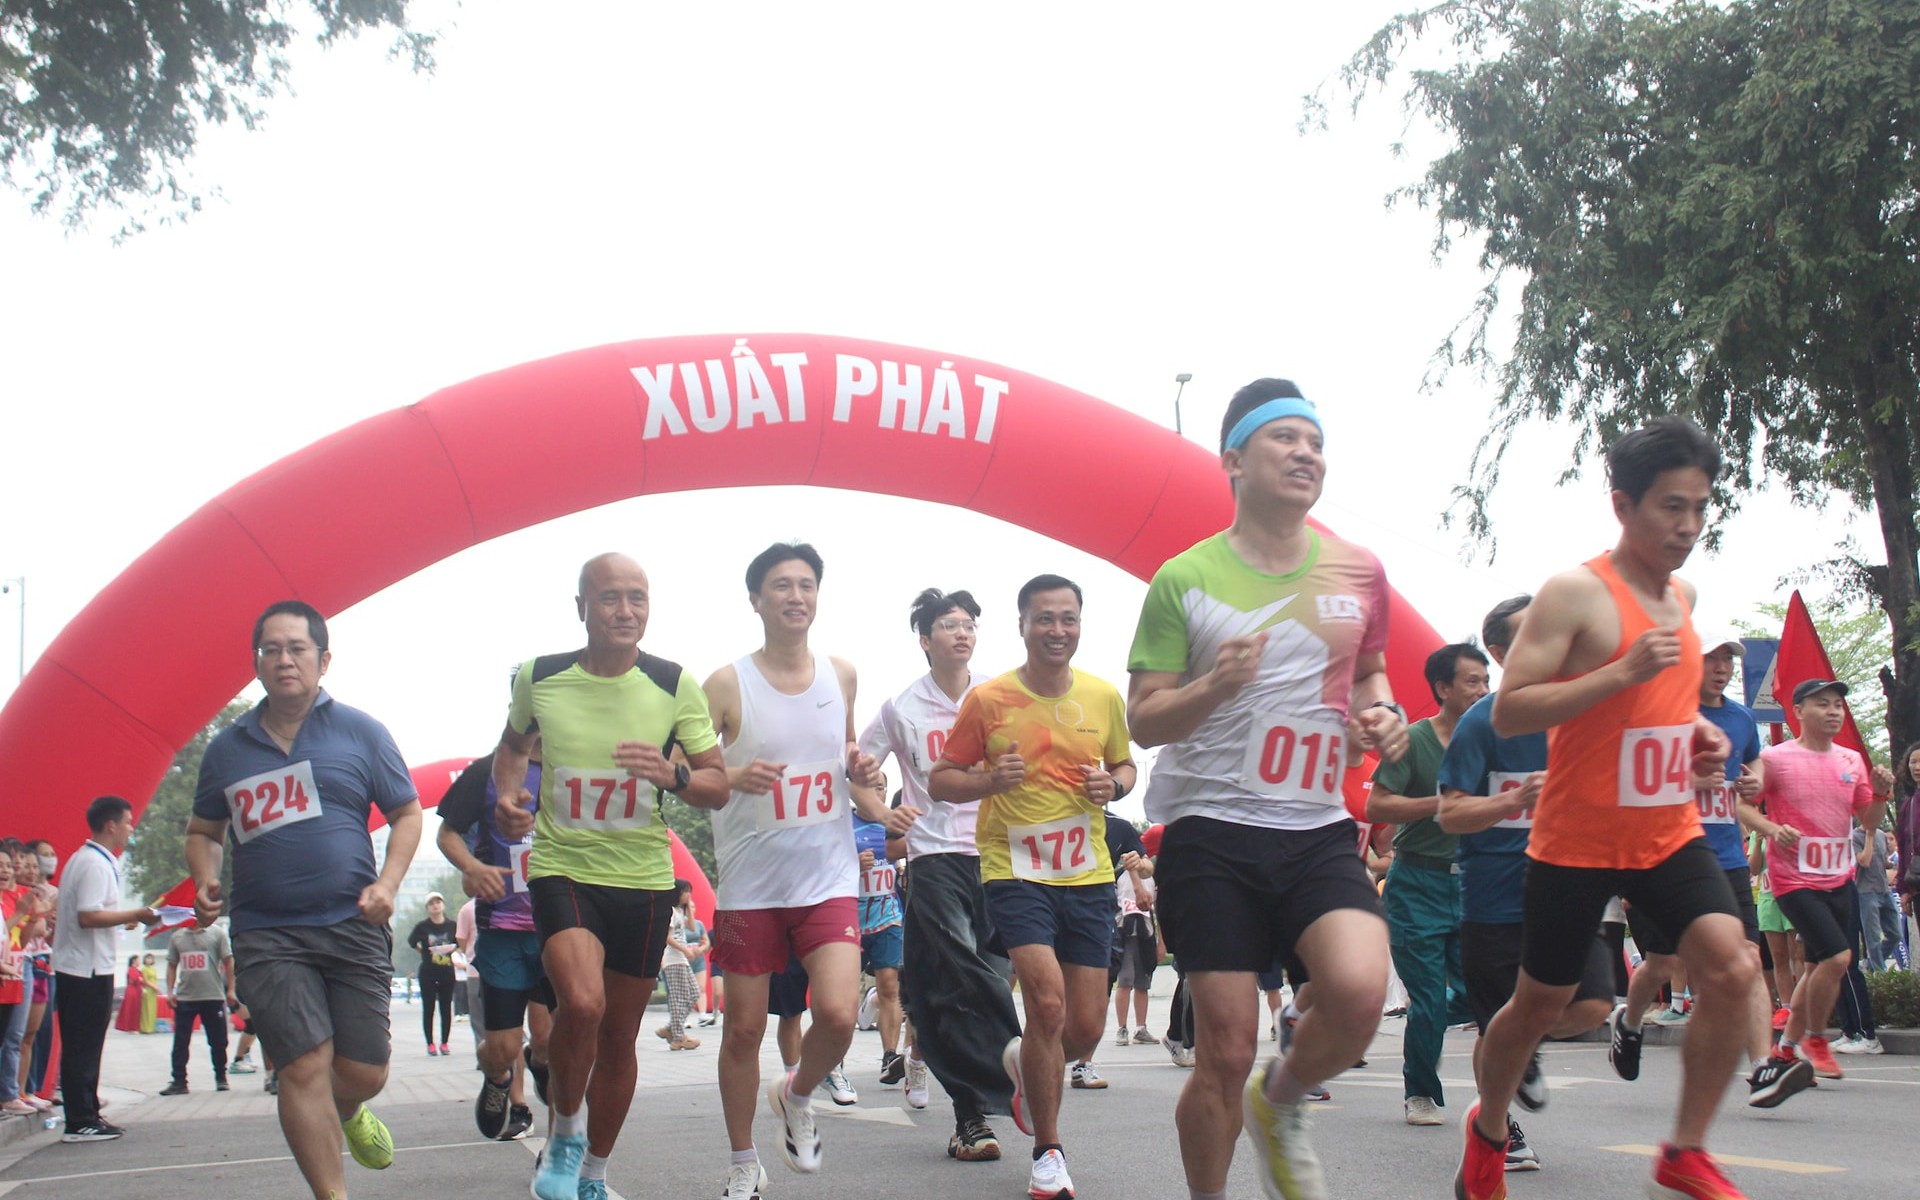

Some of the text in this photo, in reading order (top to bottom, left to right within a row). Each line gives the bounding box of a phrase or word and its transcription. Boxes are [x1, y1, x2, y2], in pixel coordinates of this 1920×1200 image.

[630, 338, 1009, 444] XUẤT PHÁT
[1258, 725, 1341, 793] 015
[1634, 737, 1695, 795] 04
[234, 774, 309, 833] 224
[565, 777, 637, 820] 171
[769, 771, 833, 820] 173
[1022, 826, 1085, 870] 172
[1806, 841, 1845, 870] 017
[861, 868, 894, 893] 170
